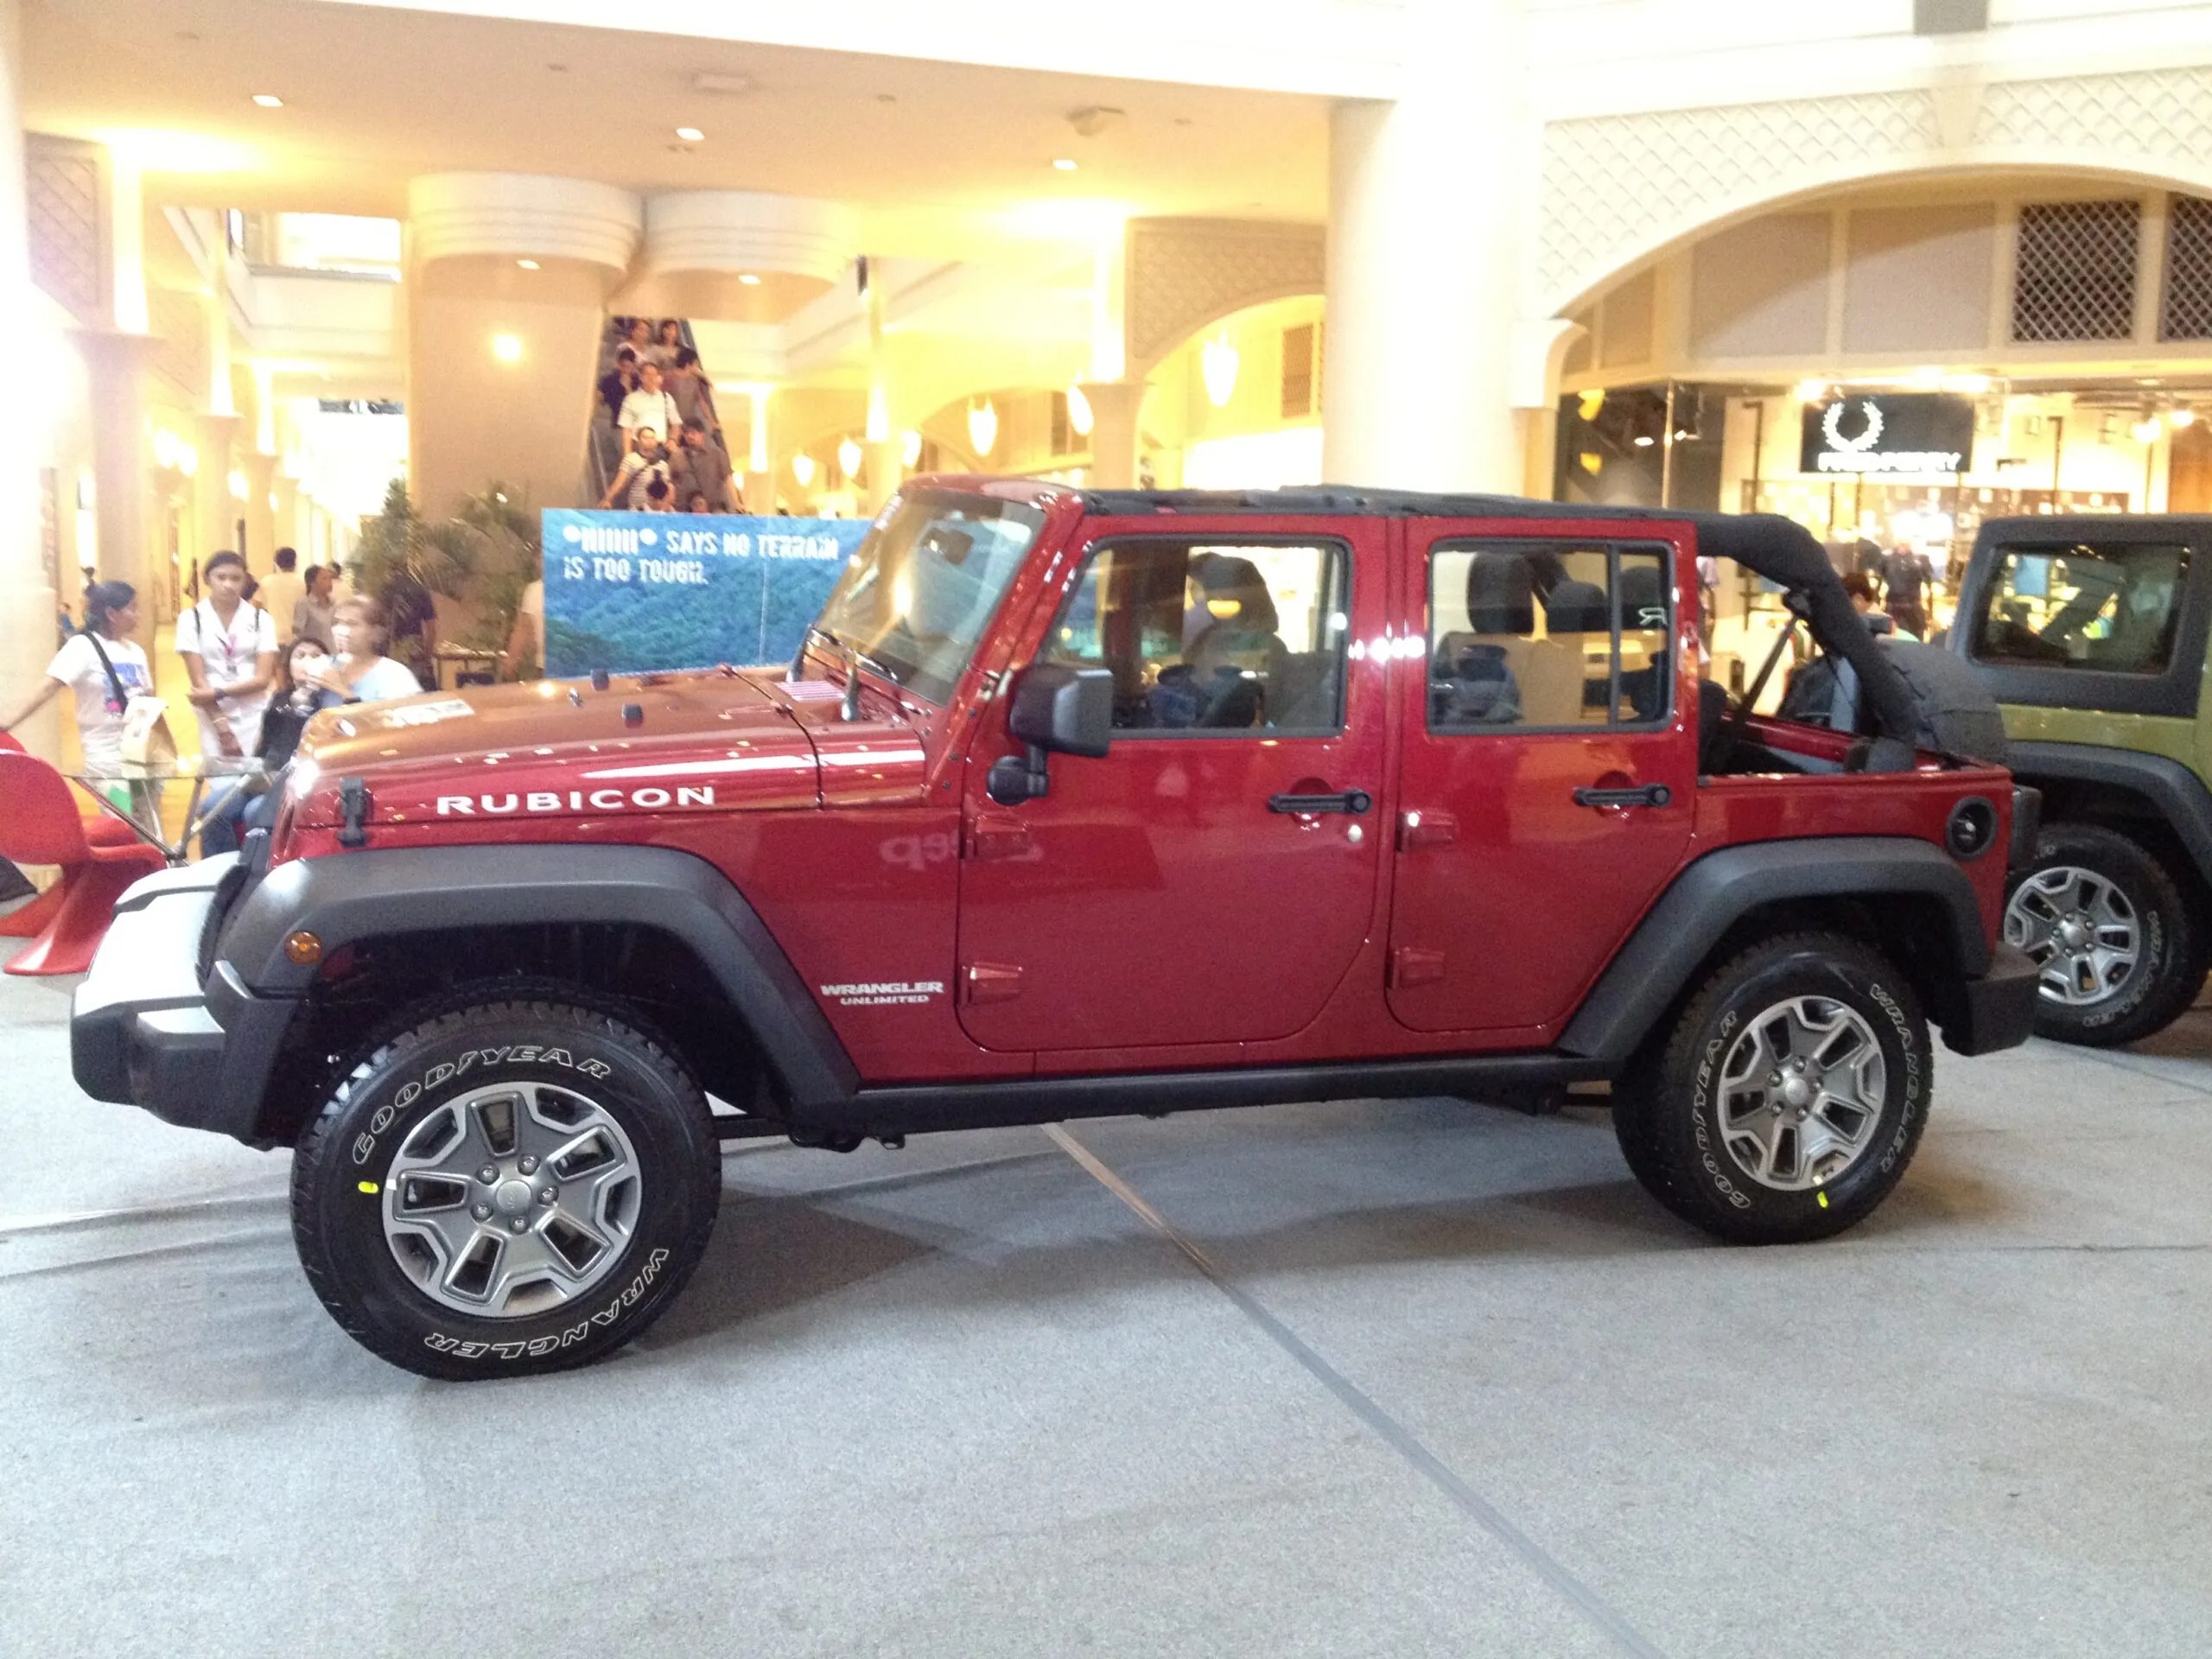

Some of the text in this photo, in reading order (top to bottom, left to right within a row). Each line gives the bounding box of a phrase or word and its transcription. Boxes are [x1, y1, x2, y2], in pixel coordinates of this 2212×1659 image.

[666, 530, 715, 554] SAYS
[723, 533, 750, 557] NO
[594, 557, 630, 582] TOO
[436, 786, 715, 814] RUBICON
[821, 982, 944, 996] WRANGLER
[840, 995, 929, 1006] UNLIMITED
[352, 1045, 611, 1165] GOODYEAR
[1693, 1010, 1751, 1209] GOODYEAR
[424, 1248, 669, 1359] WRANGLER
